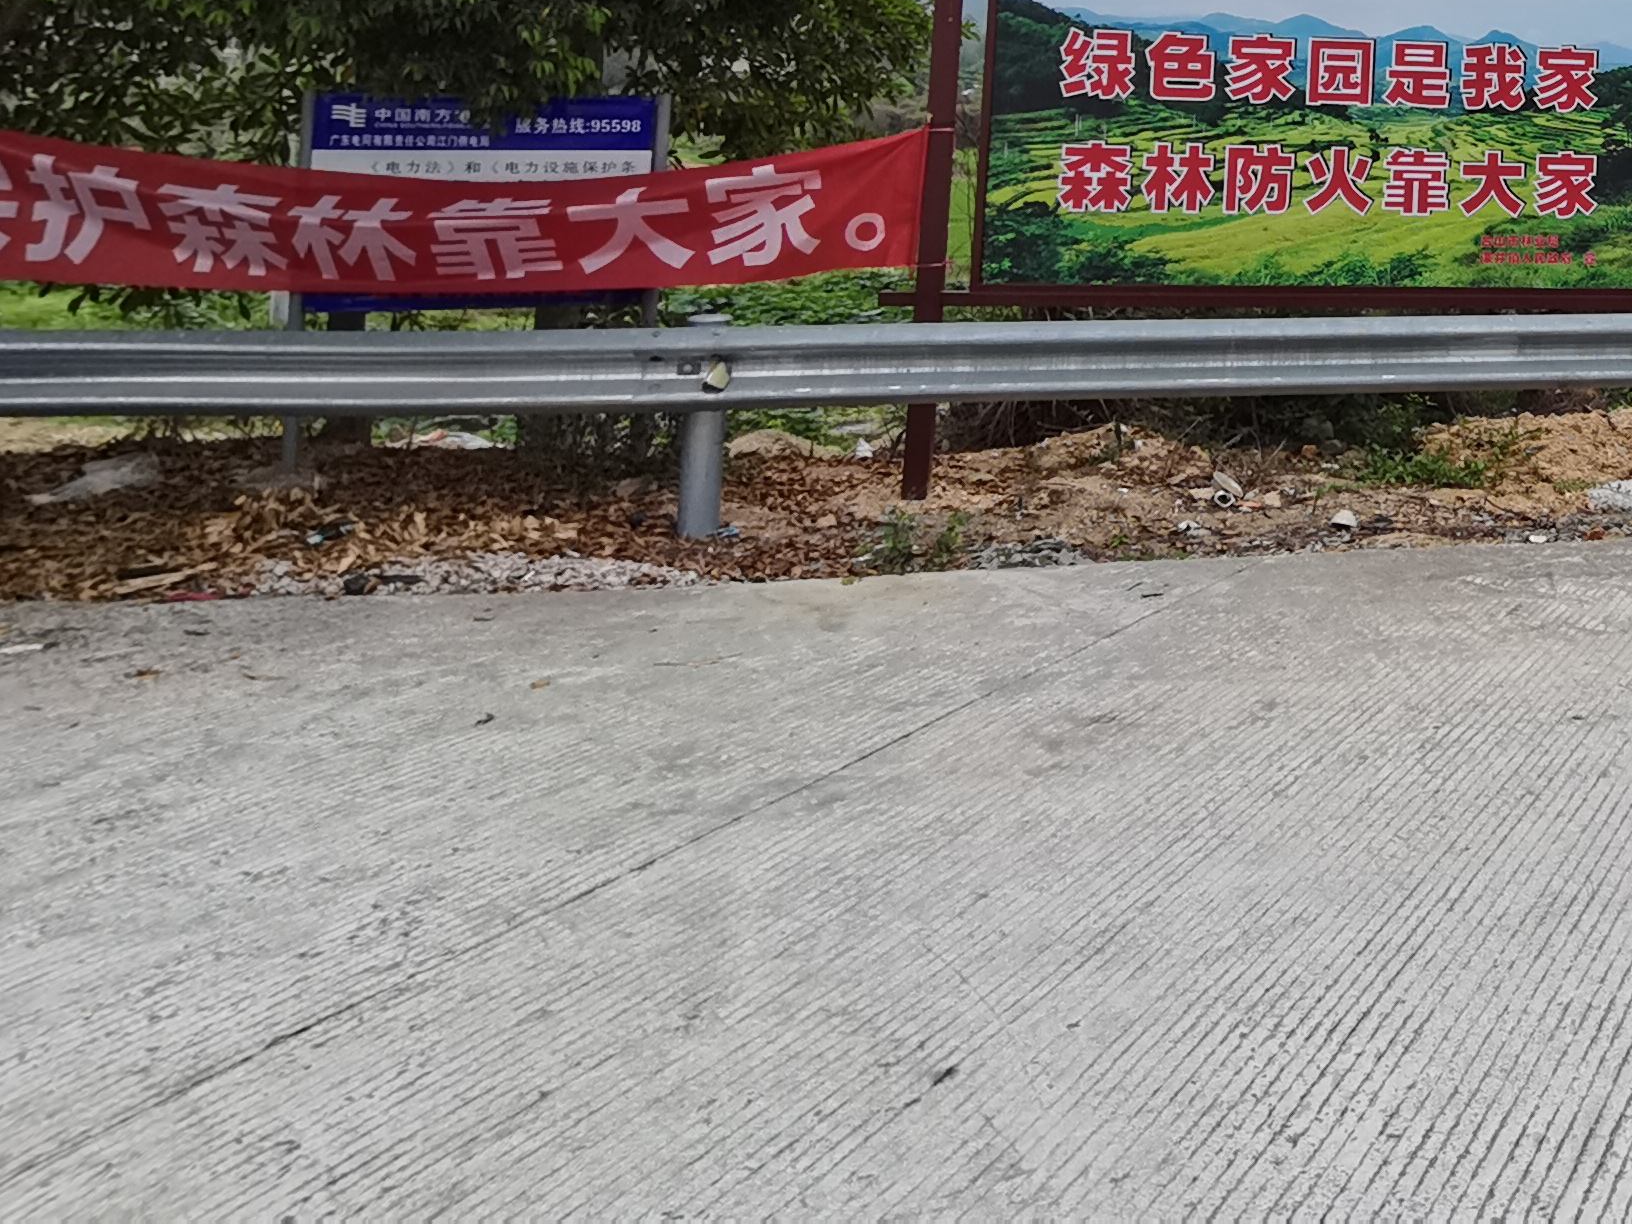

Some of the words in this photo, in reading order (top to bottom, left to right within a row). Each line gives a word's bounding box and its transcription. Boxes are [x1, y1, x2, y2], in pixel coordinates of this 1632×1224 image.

[1058, 27, 1600, 112] 绿色家园是我家
[1057, 140, 1600, 219] 森林防火靠大家
